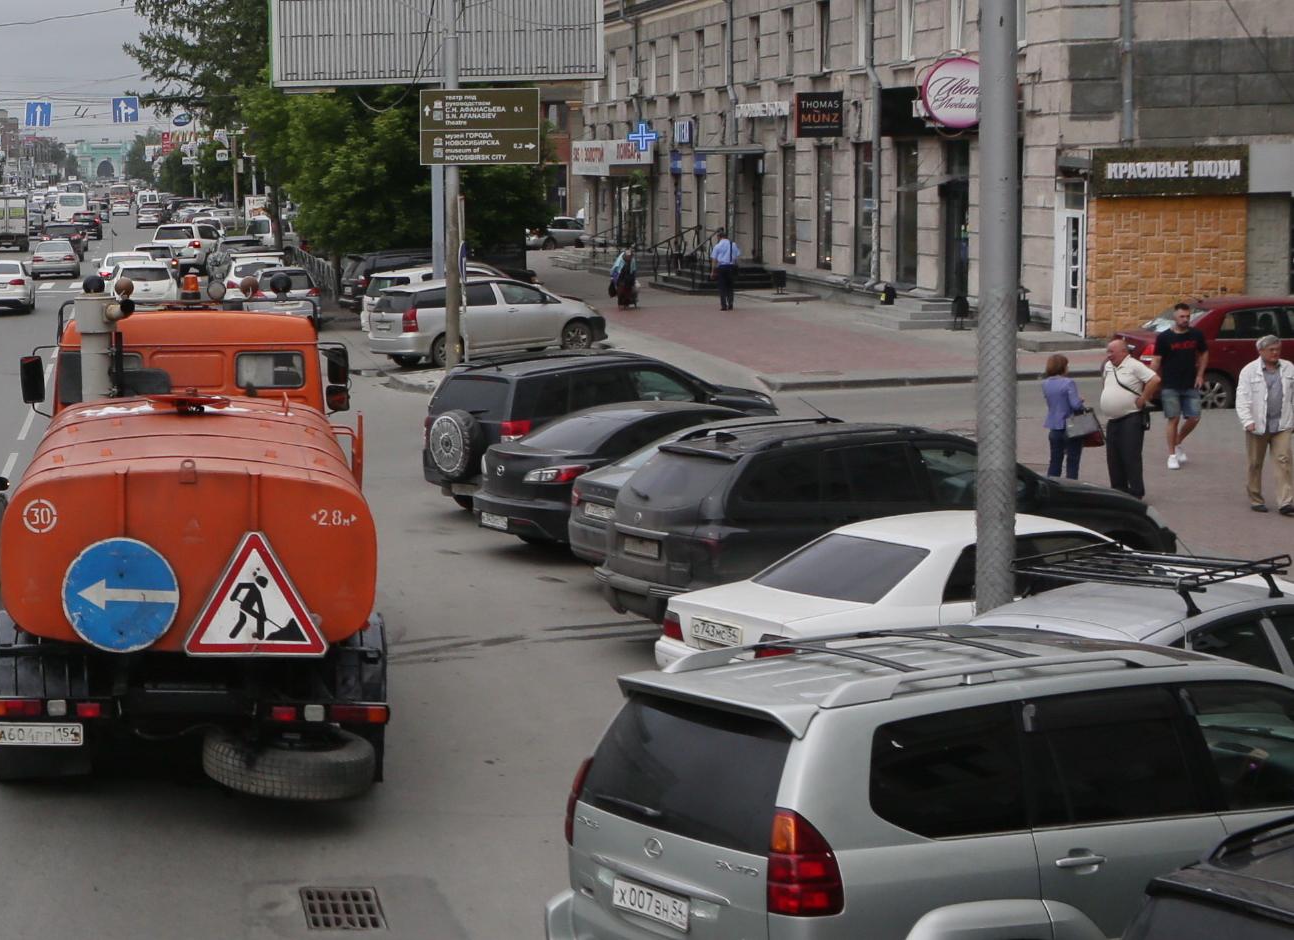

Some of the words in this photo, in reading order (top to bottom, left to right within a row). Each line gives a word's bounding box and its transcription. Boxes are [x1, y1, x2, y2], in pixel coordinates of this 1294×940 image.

[801, 100, 839, 108] THOMAS
[1107, 161, 1188, 179] КРАСИВЫЕ
[1192, 159, 1241, 179] ЛЮДИ
[30, 508, 50, 525] 30
[57, 727, 76, 738] 154
[618, 887, 669, 917] Х007ВН
[671, 903, 683, 918] 54
